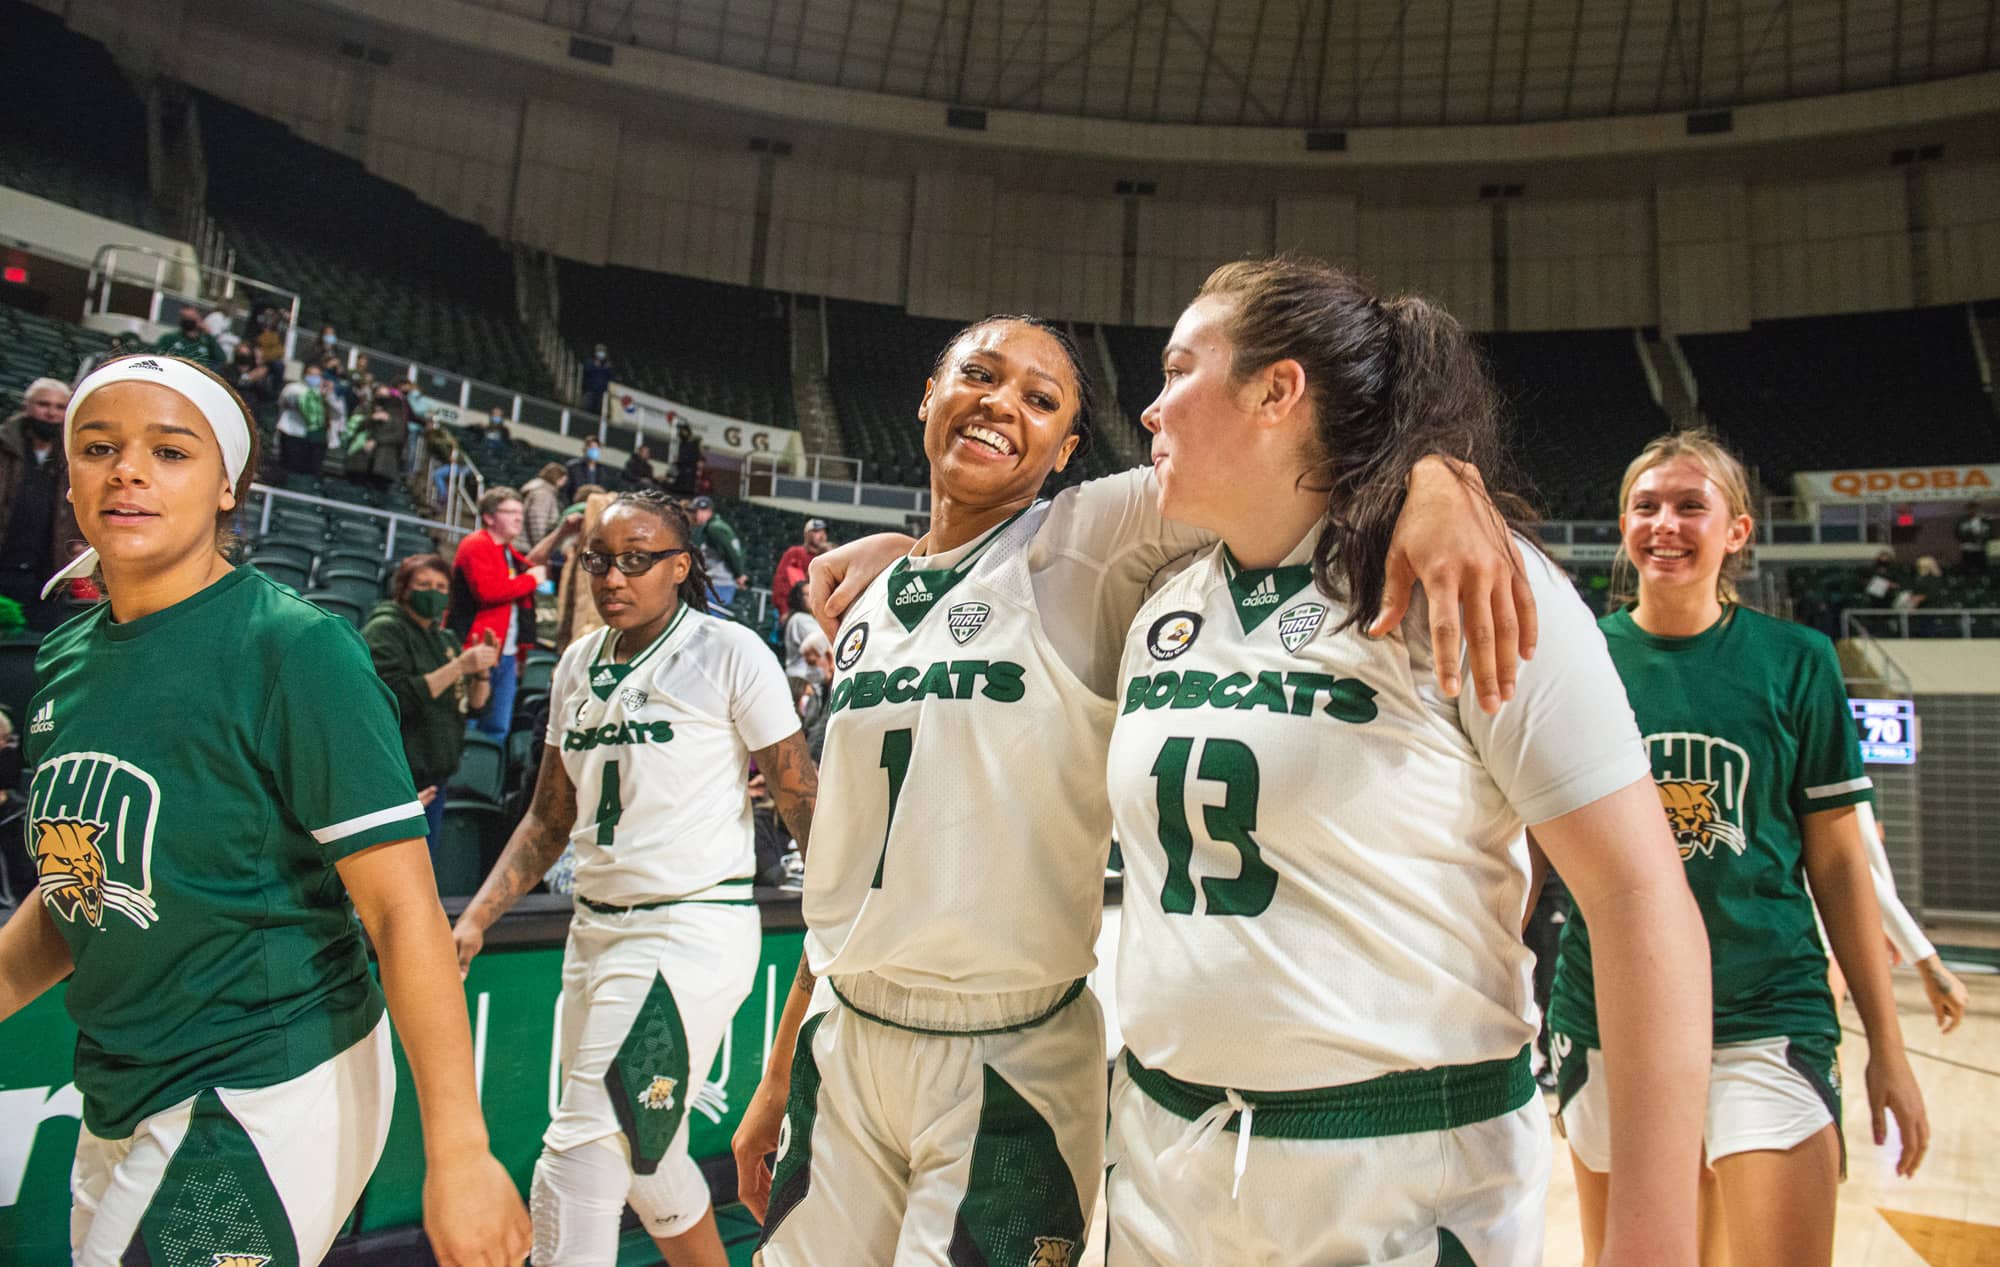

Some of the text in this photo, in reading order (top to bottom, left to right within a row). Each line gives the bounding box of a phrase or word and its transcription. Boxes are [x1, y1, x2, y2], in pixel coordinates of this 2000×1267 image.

[1832, 467, 1991, 497] QDOBA
[895, 592, 934, 606] adidas
[950, 614, 987, 626] MAC
[1242, 592, 1280, 607] adidas
[1281, 615, 1321, 634] MAC
[831, 660, 1026, 714] OBCATS
[1121, 670, 1379, 724] BOBCATS
[1864, 717, 1902, 744] 70
[595, 760, 624, 845] 4
[1641, 732, 1750, 831] HIO
[871, 728, 913, 889] 1
[1149, 736, 1280, 917] 13
